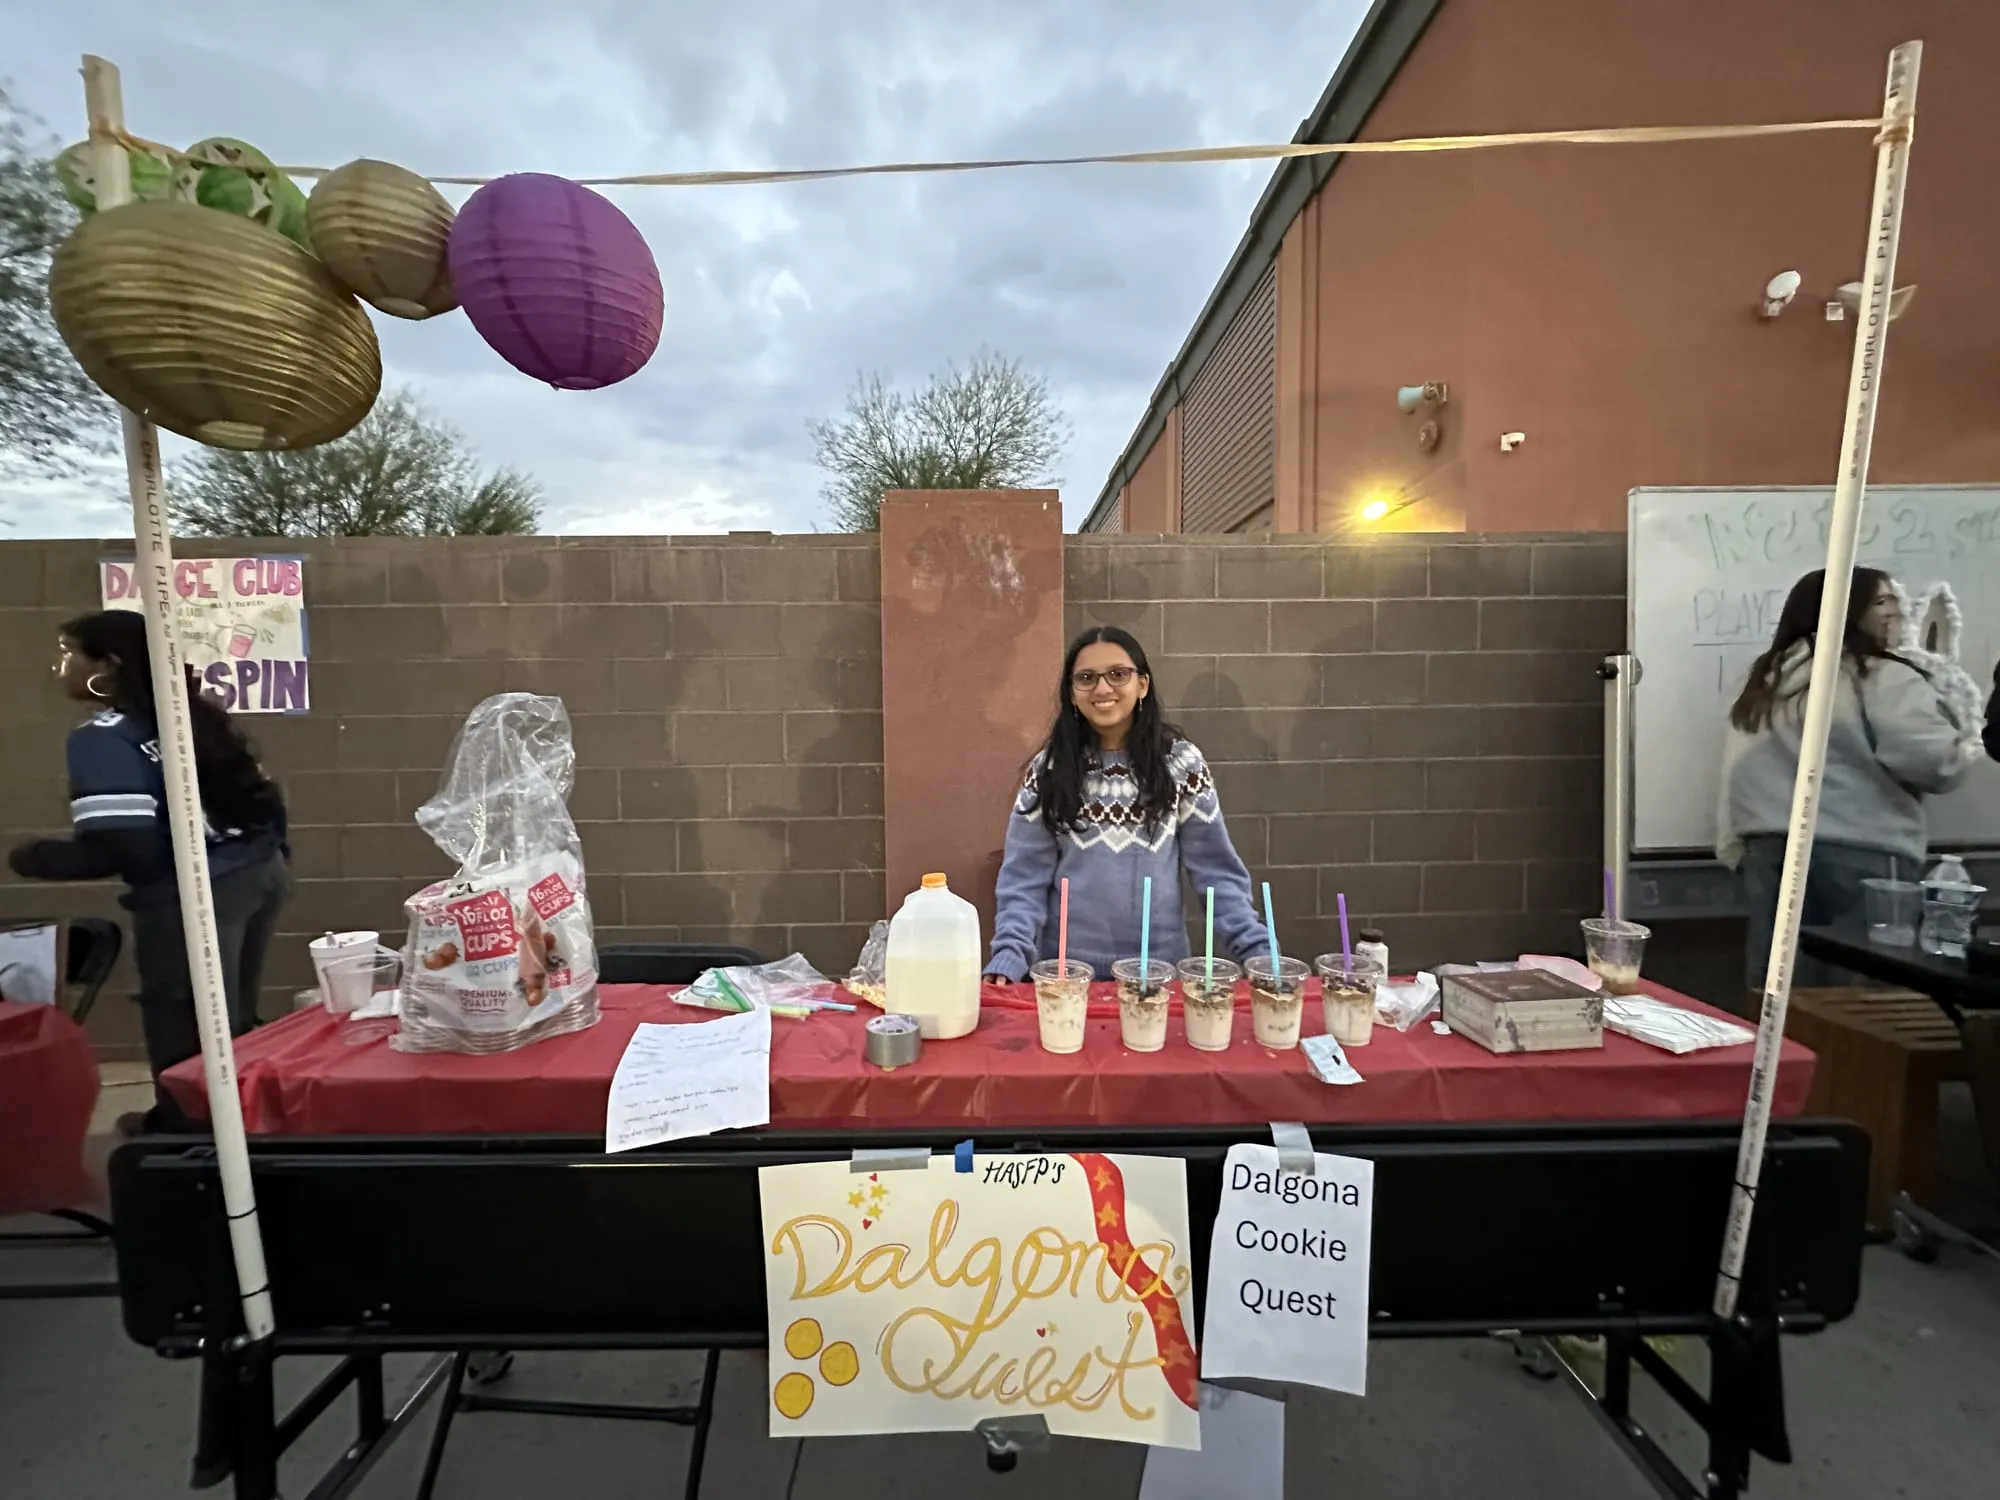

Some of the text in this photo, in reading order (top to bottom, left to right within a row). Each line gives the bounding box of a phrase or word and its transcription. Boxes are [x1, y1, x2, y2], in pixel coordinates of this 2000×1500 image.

[1859, 273, 1884, 391] CHARLOTTE
[142, 440, 163, 552] CHARLOTTE
[105, 560, 301, 600] DCE CLUB
[203, 659, 308, 711] SPIN
[454, 905, 477, 926] 16
[490, 906, 509, 921] OZ
[540, 894, 571, 915] CUPS
[466, 929, 514, 954] CUPS
[1232, 1163, 1359, 1207] Dalgona
[1236, 1220, 1347, 1262] Cookie
[772, 1199, 1190, 1331] Dalgona
[1239, 1278, 1337, 1320] Quest
[880, 1307, 1166, 1421] Quest
